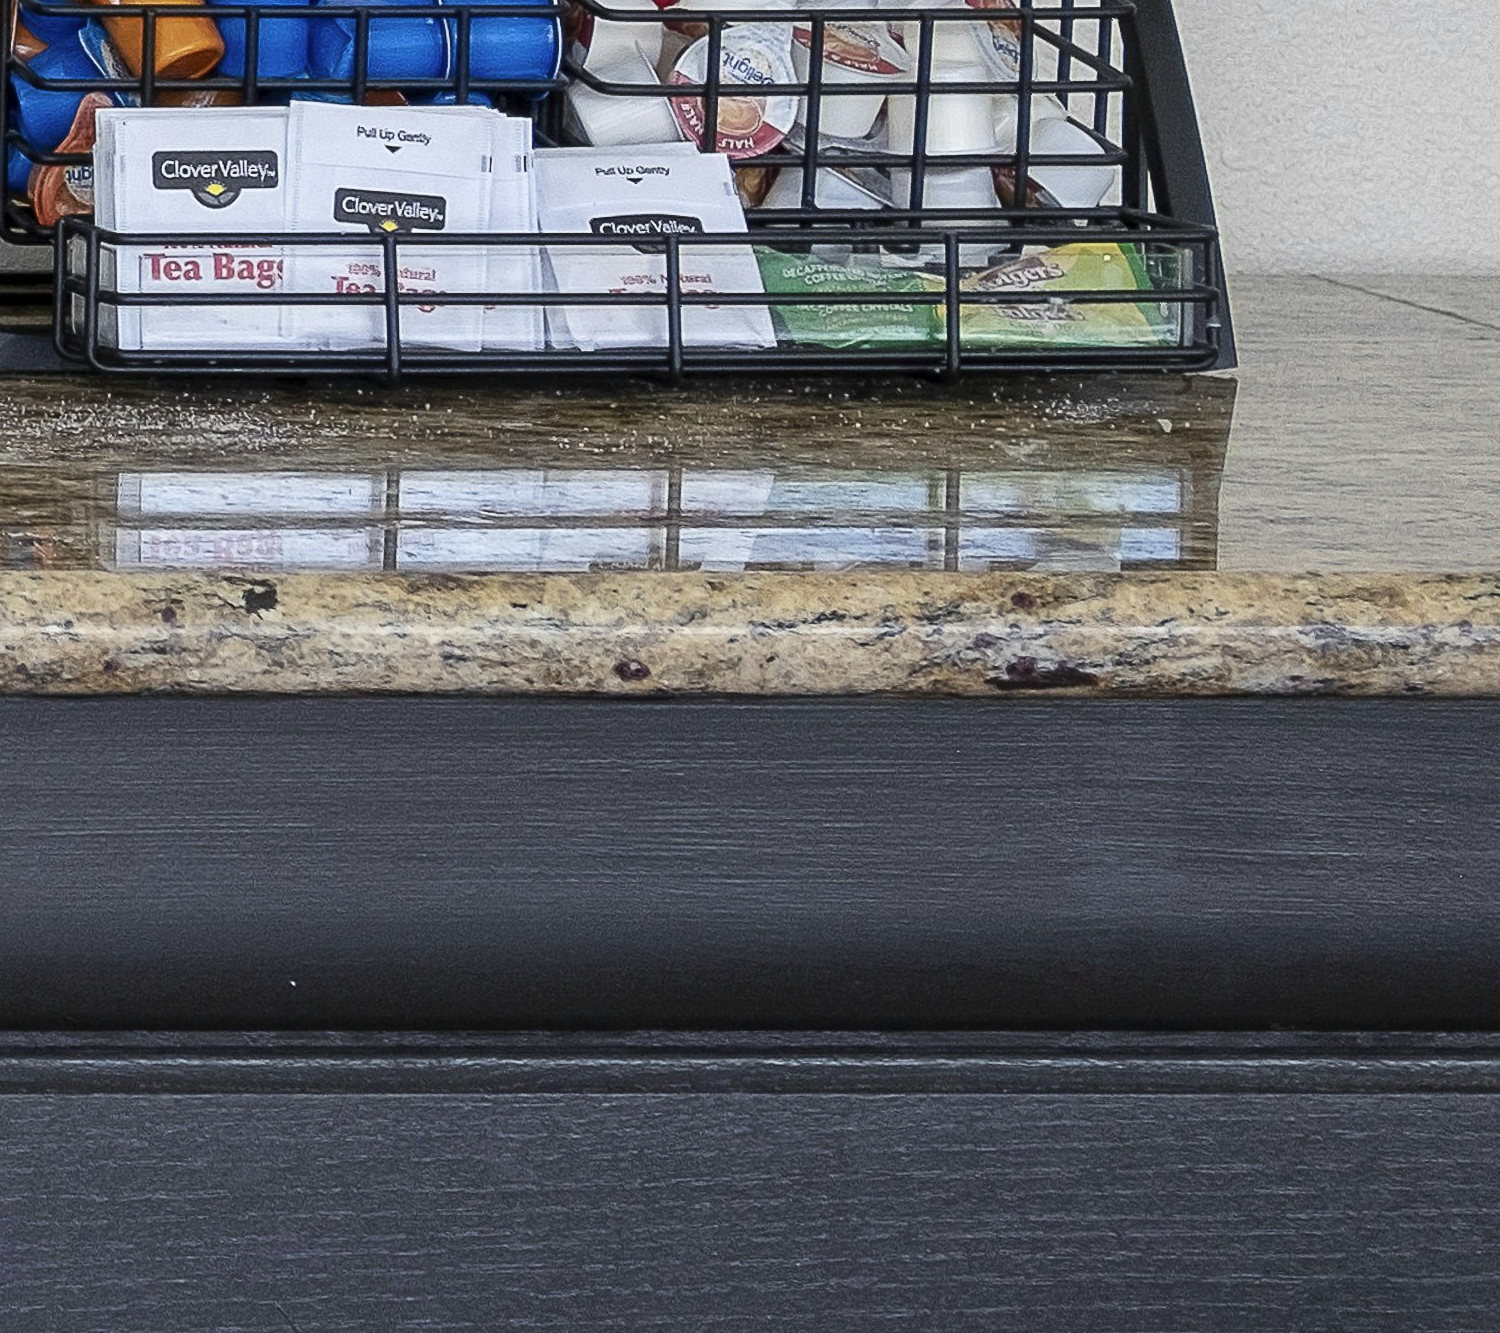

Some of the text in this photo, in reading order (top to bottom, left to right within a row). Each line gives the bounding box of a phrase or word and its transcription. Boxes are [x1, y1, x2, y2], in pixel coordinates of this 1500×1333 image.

[356, 125, 432, 146] Pull Up Gently
[717, 135, 755, 150] HALF
[595, 166, 616, 176] Pull
[617, 166, 634, 176] Up
[144, 252, 203, 281] Tea
